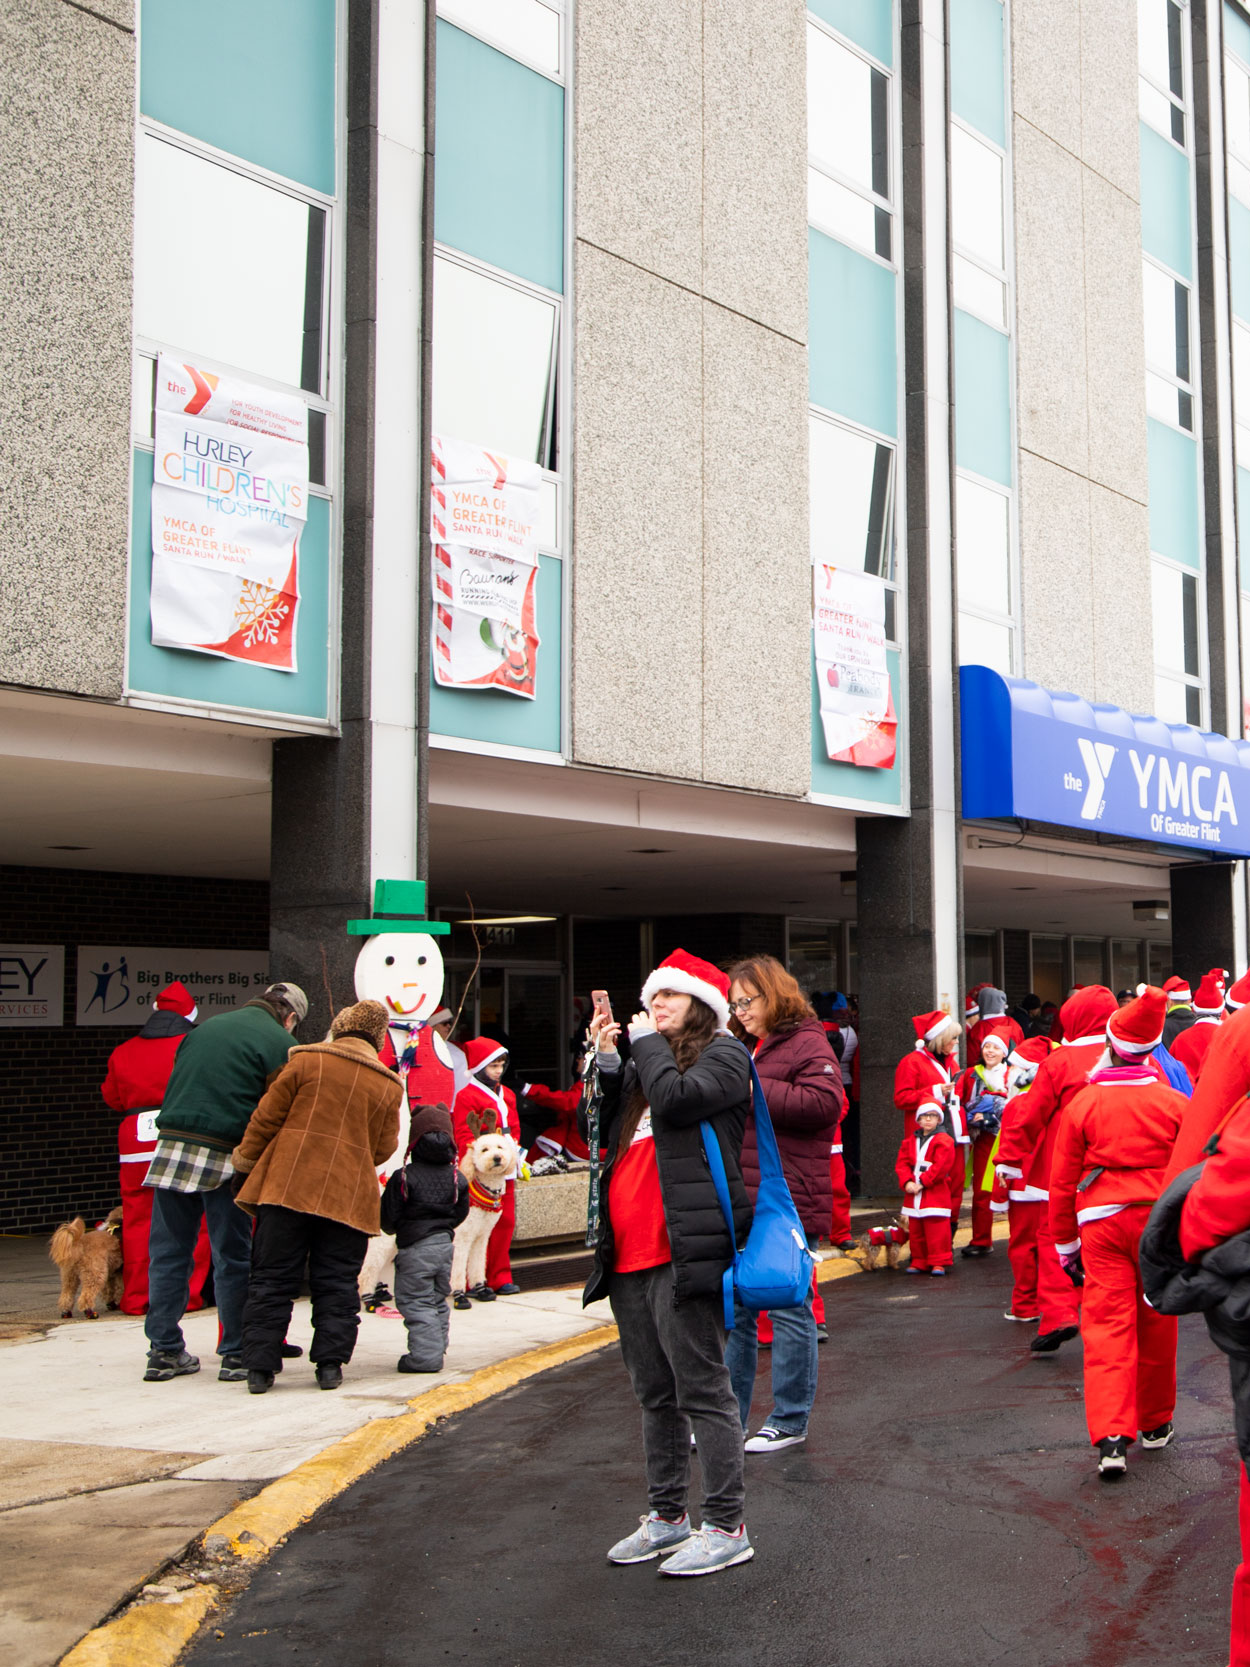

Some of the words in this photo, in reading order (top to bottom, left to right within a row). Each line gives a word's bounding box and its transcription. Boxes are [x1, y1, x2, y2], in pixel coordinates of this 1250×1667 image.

[168, 381, 187, 395] the
[229, 408, 241, 417] FOR
[242, 412, 267, 425] HEALTHY
[268, 421, 287, 432] LIVING
[183, 431, 253, 468] HURLEY
[163, 452, 302, 508] CHILDREN'S
[452, 490, 489, 508] YMCA
[493, 497, 508, 511] OF
[206, 495, 289, 528] HOSPITAL
[452, 508, 507, 526] GREATER
[508, 519, 532, 536] FLINT
[163, 515, 197, 534] YMCA
[201, 525, 216, 537] OF
[452, 522, 483, 535] SANTA
[162, 531, 219, 551] GREATER
[223, 543, 252, 556] FLINT
[163, 543, 192, 556] SANTA
[194, 551, 214, 560] RUN
[223, 554, 246, 564] WALK
[469, 548, 487, 558] RACE
[819, 608, 854, 625] GREATER
[818, 621, 843, 636] SANTA
[1064, 772, 1083, 792] the
[1128, 749, 1238, 826] YMCA
[1151, 813, 1164, 833] Of
[1165, 816, 1200, 840] Greater
[1201, 823, 1221, 843] Flint
[137, 970, 160, 987] Big
[165, 971, 224, 985] Brothers
[228, 972, 249, 988] Big
[136, 992, 151, 1005] of
[209, 993, 236, 1005] Flint
